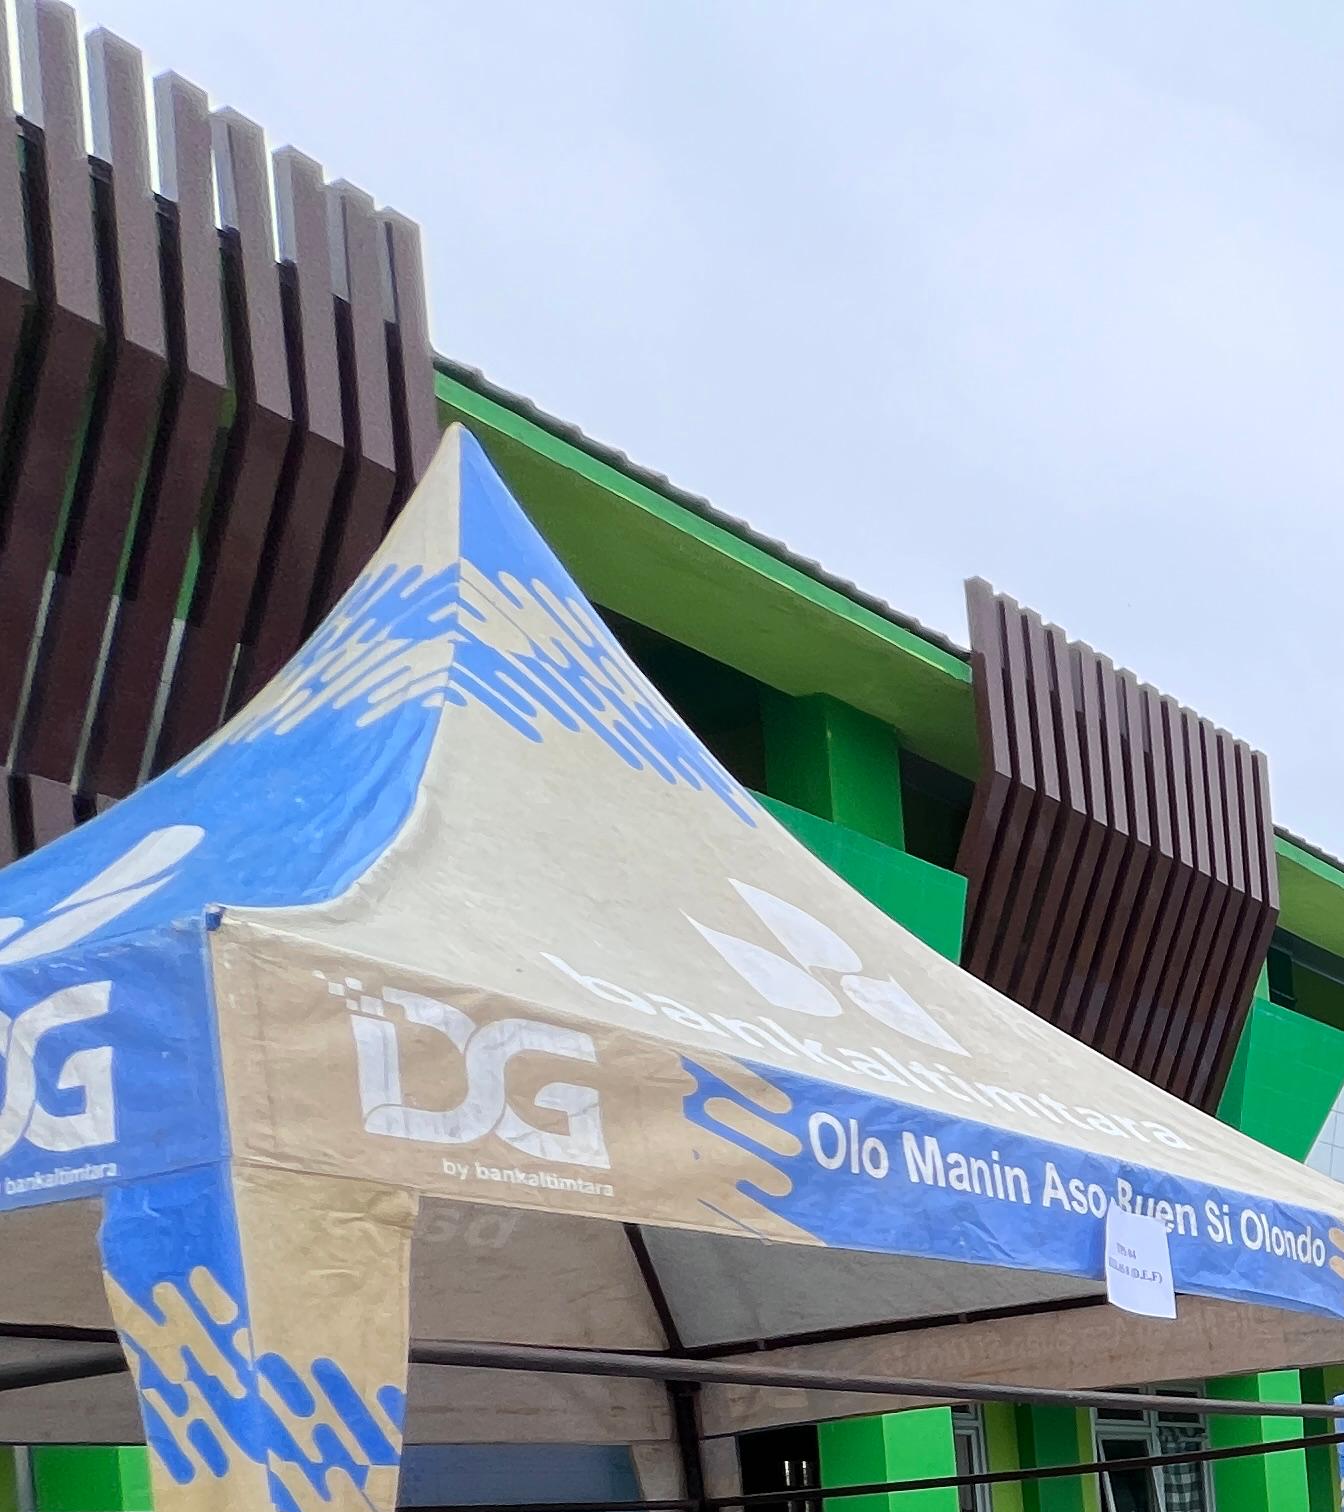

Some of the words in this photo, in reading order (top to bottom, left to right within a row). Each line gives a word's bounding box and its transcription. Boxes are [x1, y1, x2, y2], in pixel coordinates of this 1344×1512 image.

[0, 979, 119, 1157] G
[539, 952, 1194, 1151] bankaltimtara
[4, 1162, 119, 1196] bankaltimtara
[441, 1157, 468, 1181] by
[474, 1161, 615, 1198] bankaltimtara
[808, 1112, 889, 1180] Olo
[902, 1131, 1030, 1204] Manin
[1042, 1162, 1107, 1219] Aso
[1204, 1199, 1233, 1245] Si
[1240, 1209, 1326, 1268] Olondo
